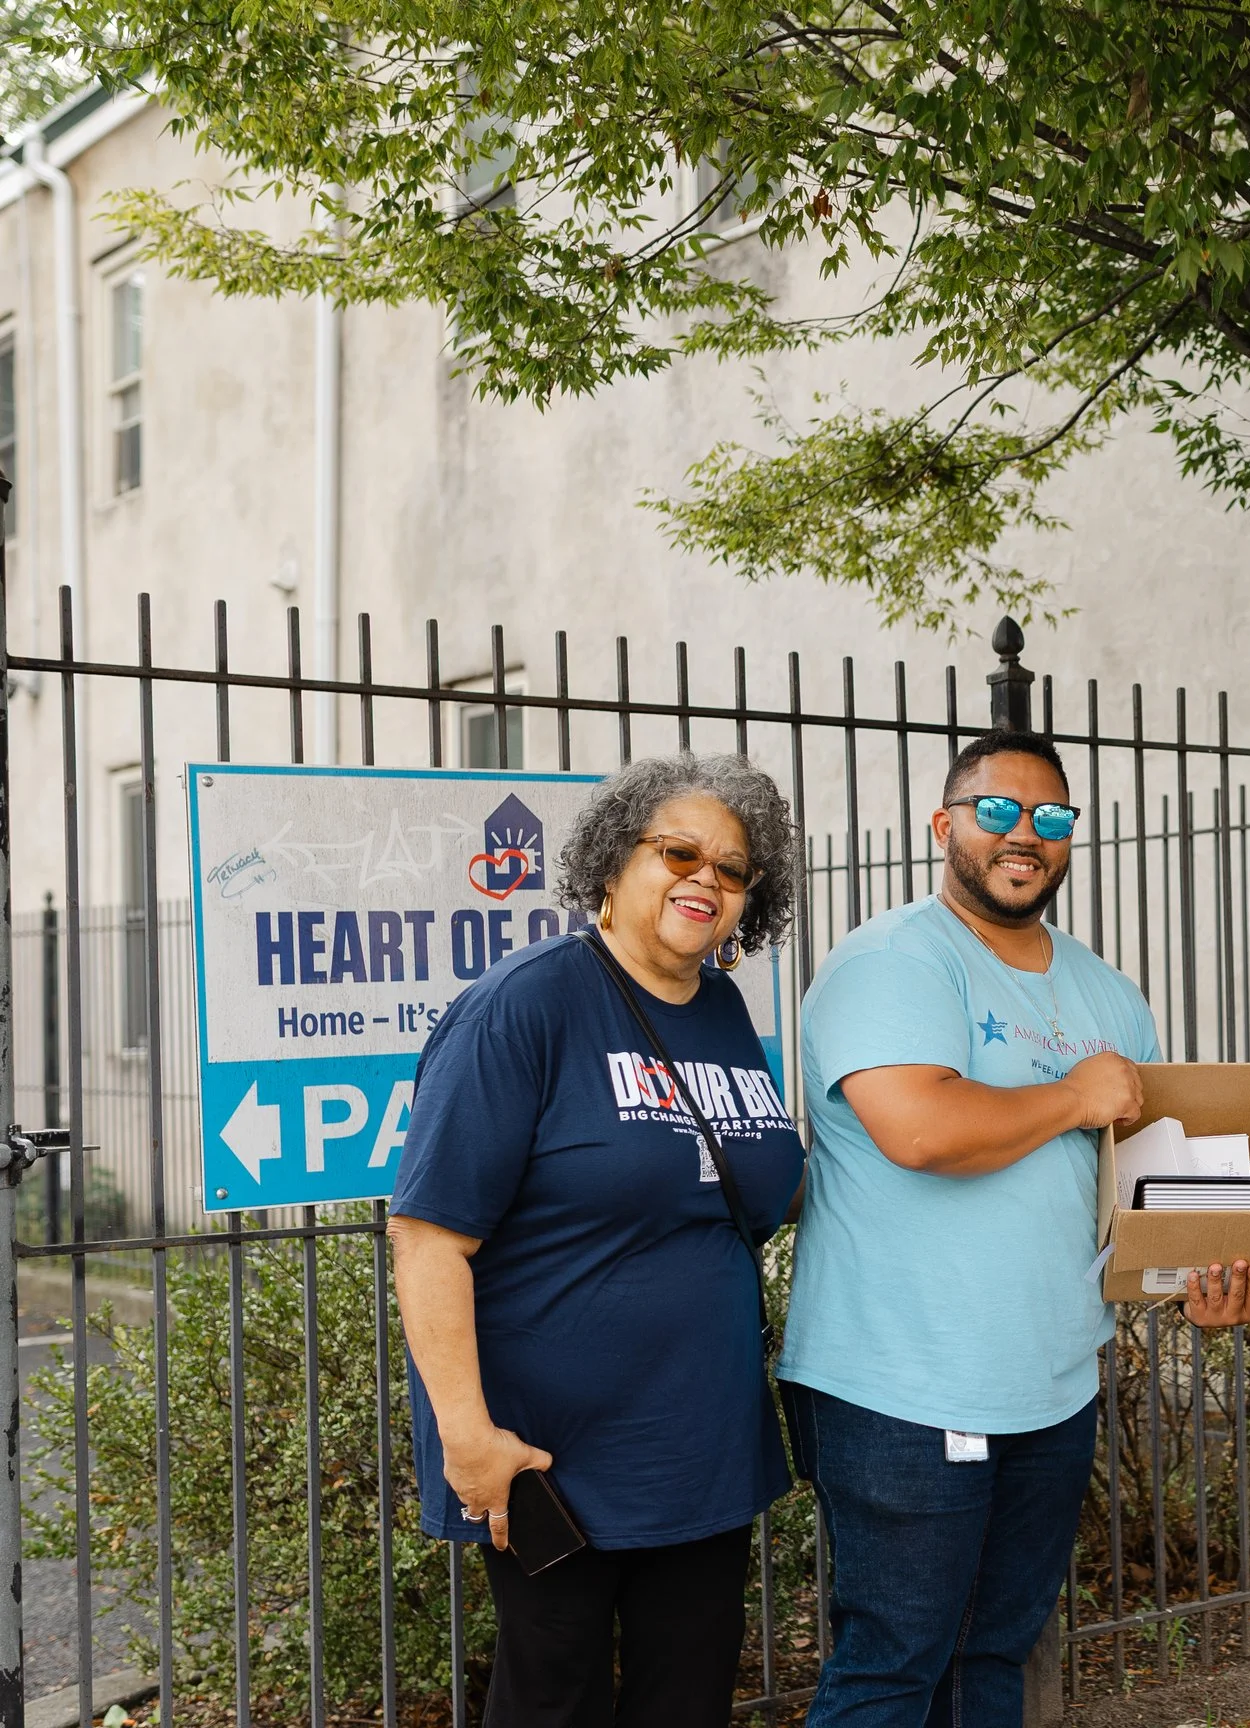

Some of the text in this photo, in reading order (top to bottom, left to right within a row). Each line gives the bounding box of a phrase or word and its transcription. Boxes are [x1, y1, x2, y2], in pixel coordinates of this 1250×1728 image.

[255, 910, 434, 986] HEART
[450, 909, 513, 980] OF
[278, 1006, 365, 1038] Home
[1014, 1025, 1077, 1055] AMEICAN
[730, 1066, 789, 1119] BIT
[619, 1110, 648, 1121] BIG
[650, 1110, 700, 1128] CHANGE
[710, 1119, 751, 1131] TART
